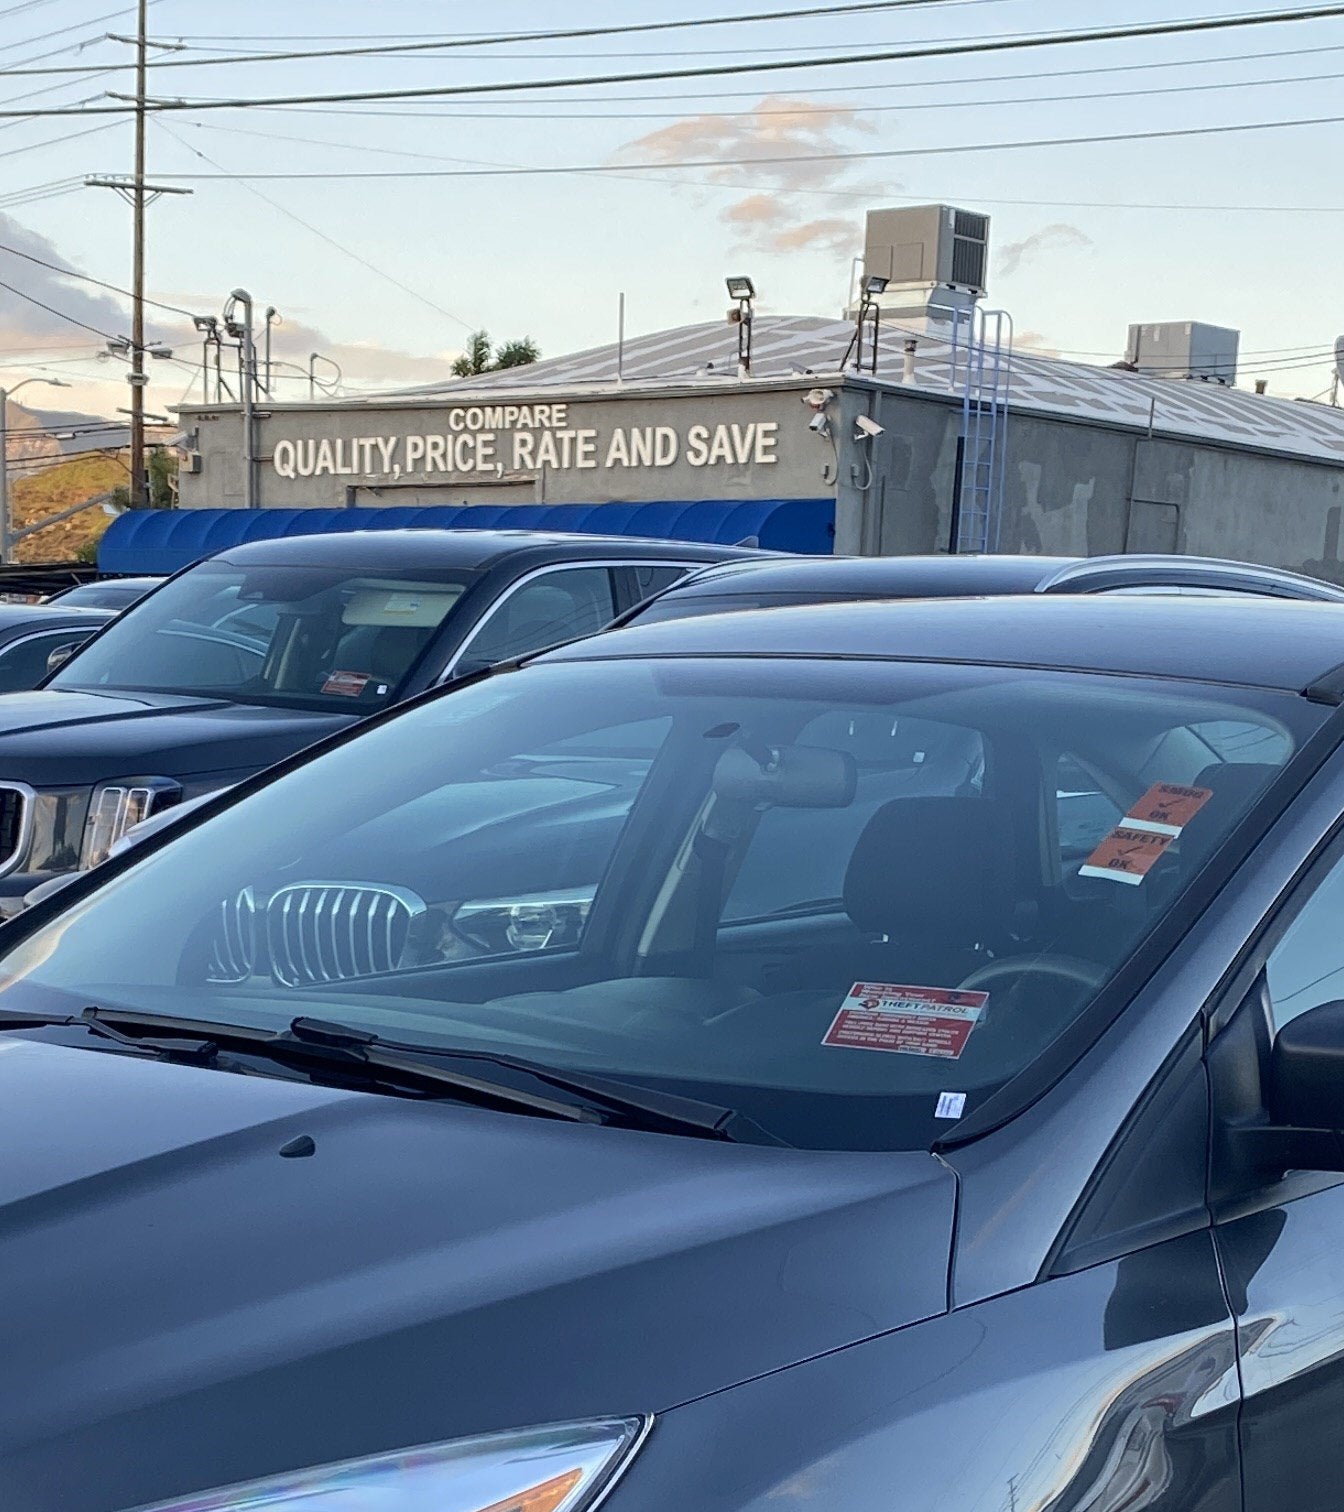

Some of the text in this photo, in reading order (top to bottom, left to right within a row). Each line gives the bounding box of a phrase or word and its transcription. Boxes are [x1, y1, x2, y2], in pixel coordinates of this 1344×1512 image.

[449, 403, 567, 431] COMPARE
[273, 422, 778, 480] QUALITY, PRICE, RATE AND SAVE
[1112, 830, 1172, 845] SAFETY
